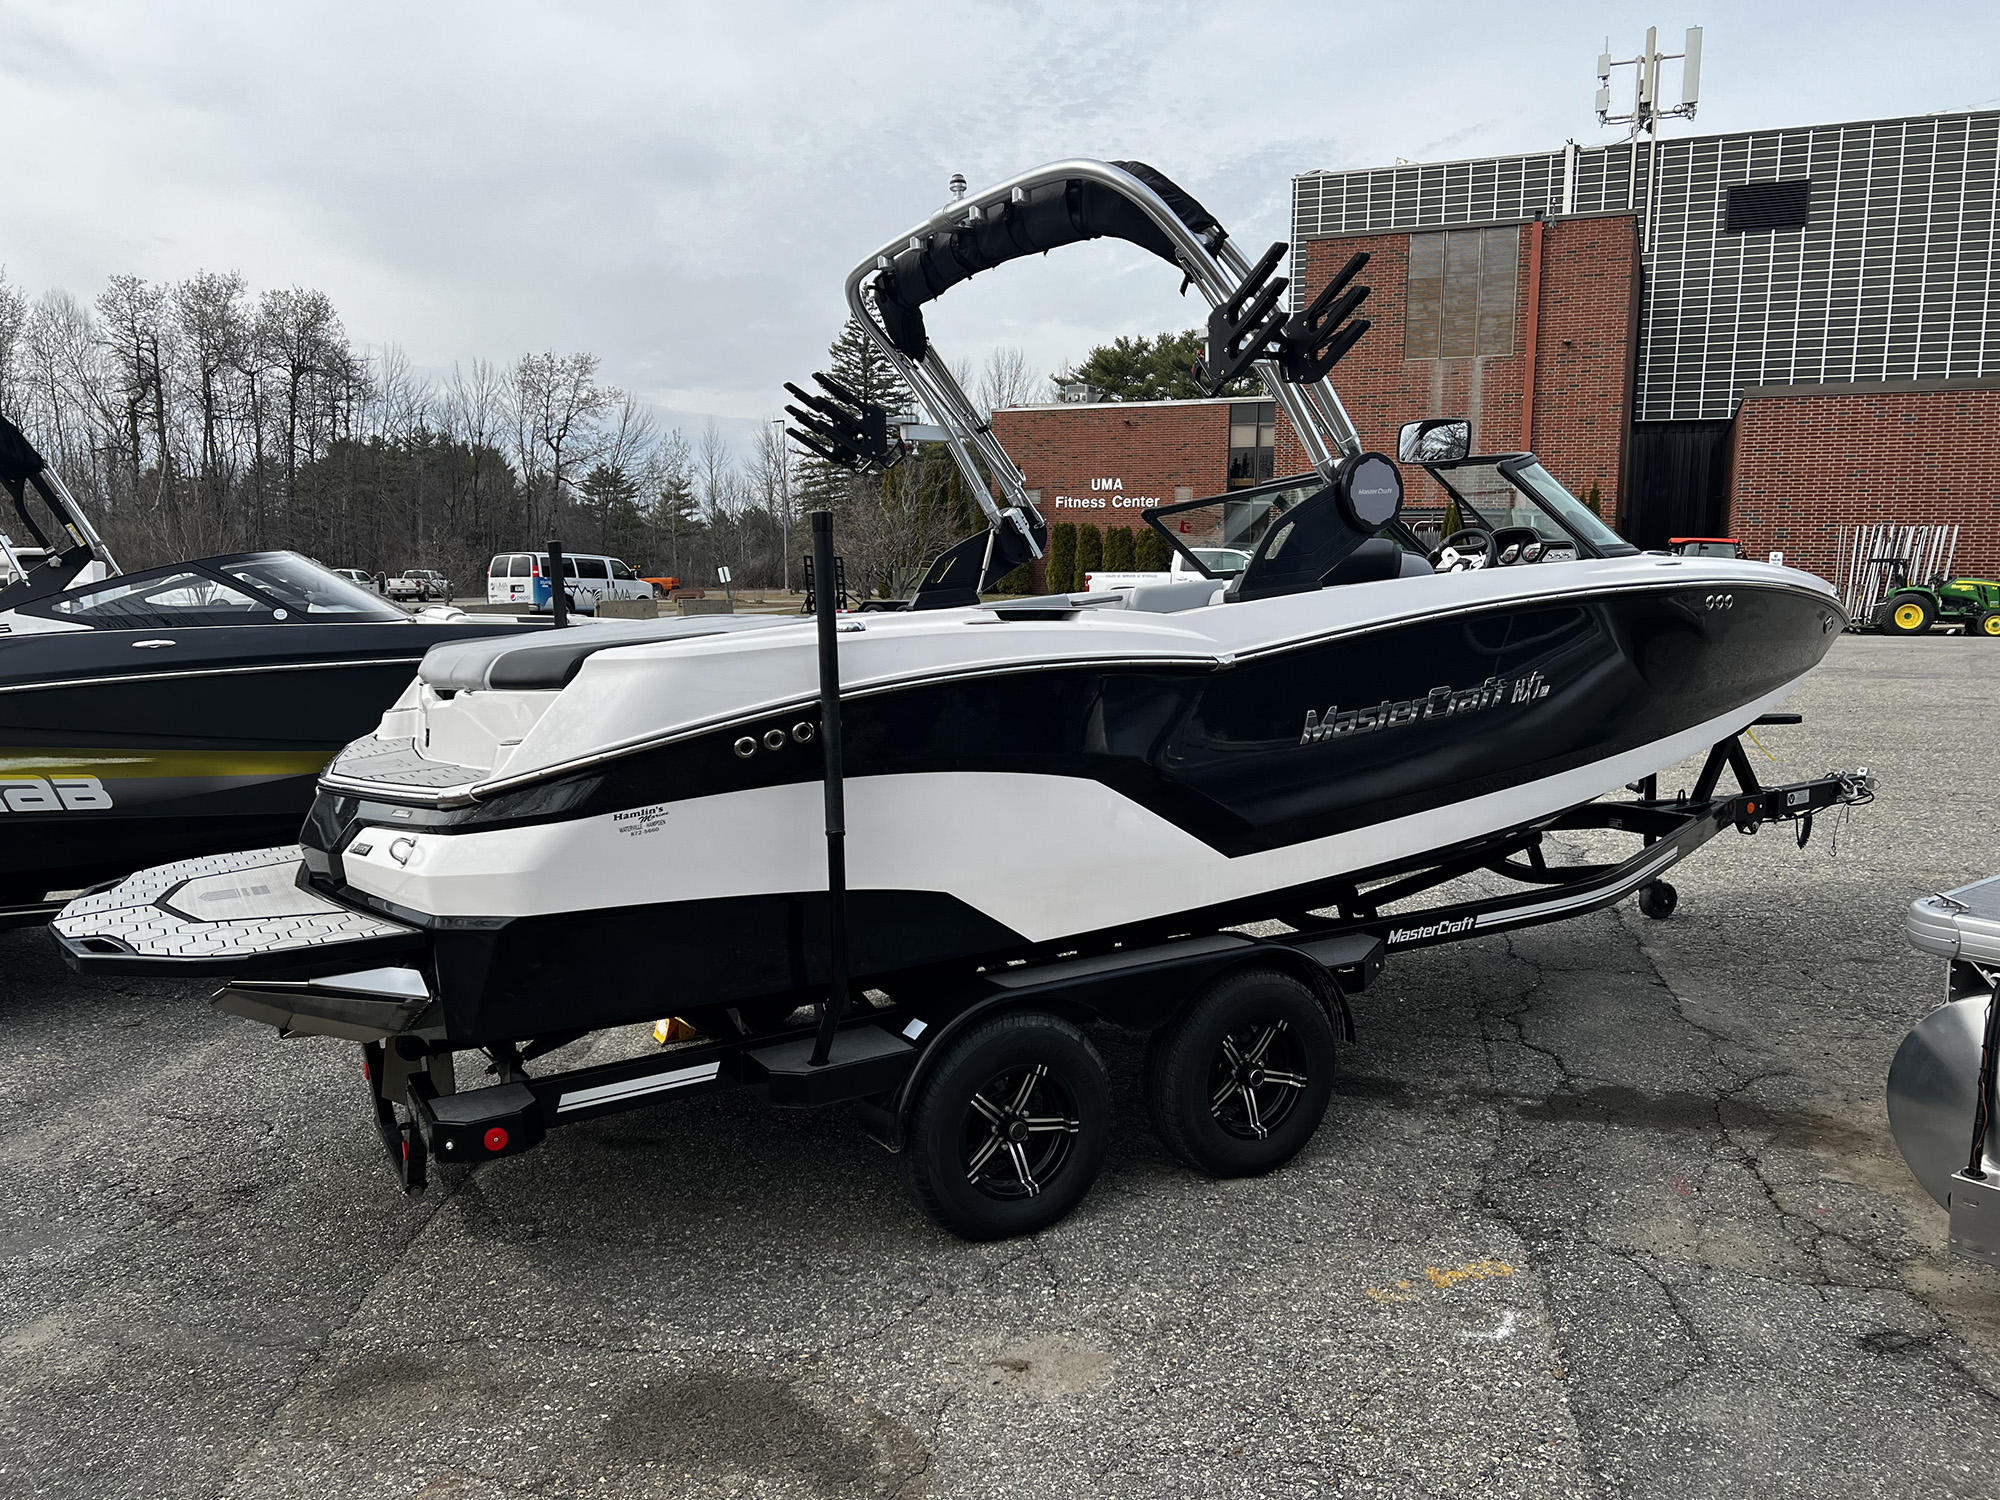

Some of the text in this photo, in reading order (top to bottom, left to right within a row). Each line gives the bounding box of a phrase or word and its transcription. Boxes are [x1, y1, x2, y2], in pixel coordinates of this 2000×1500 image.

[1091, 478, 1123, 491] UMA
[1358, 487, 1392, 495] MasterCraft
[1055, 495, 1160, 508] Fitness Center
[607, 588, 632, 601] UMA
[1300, 677, 1508, 745] MasterCraft
[613, 806, 663, 821] Hamlin's
[638, 811, 669, 823] Marine
[1387, 917, 1475, 944] MasterCraft
